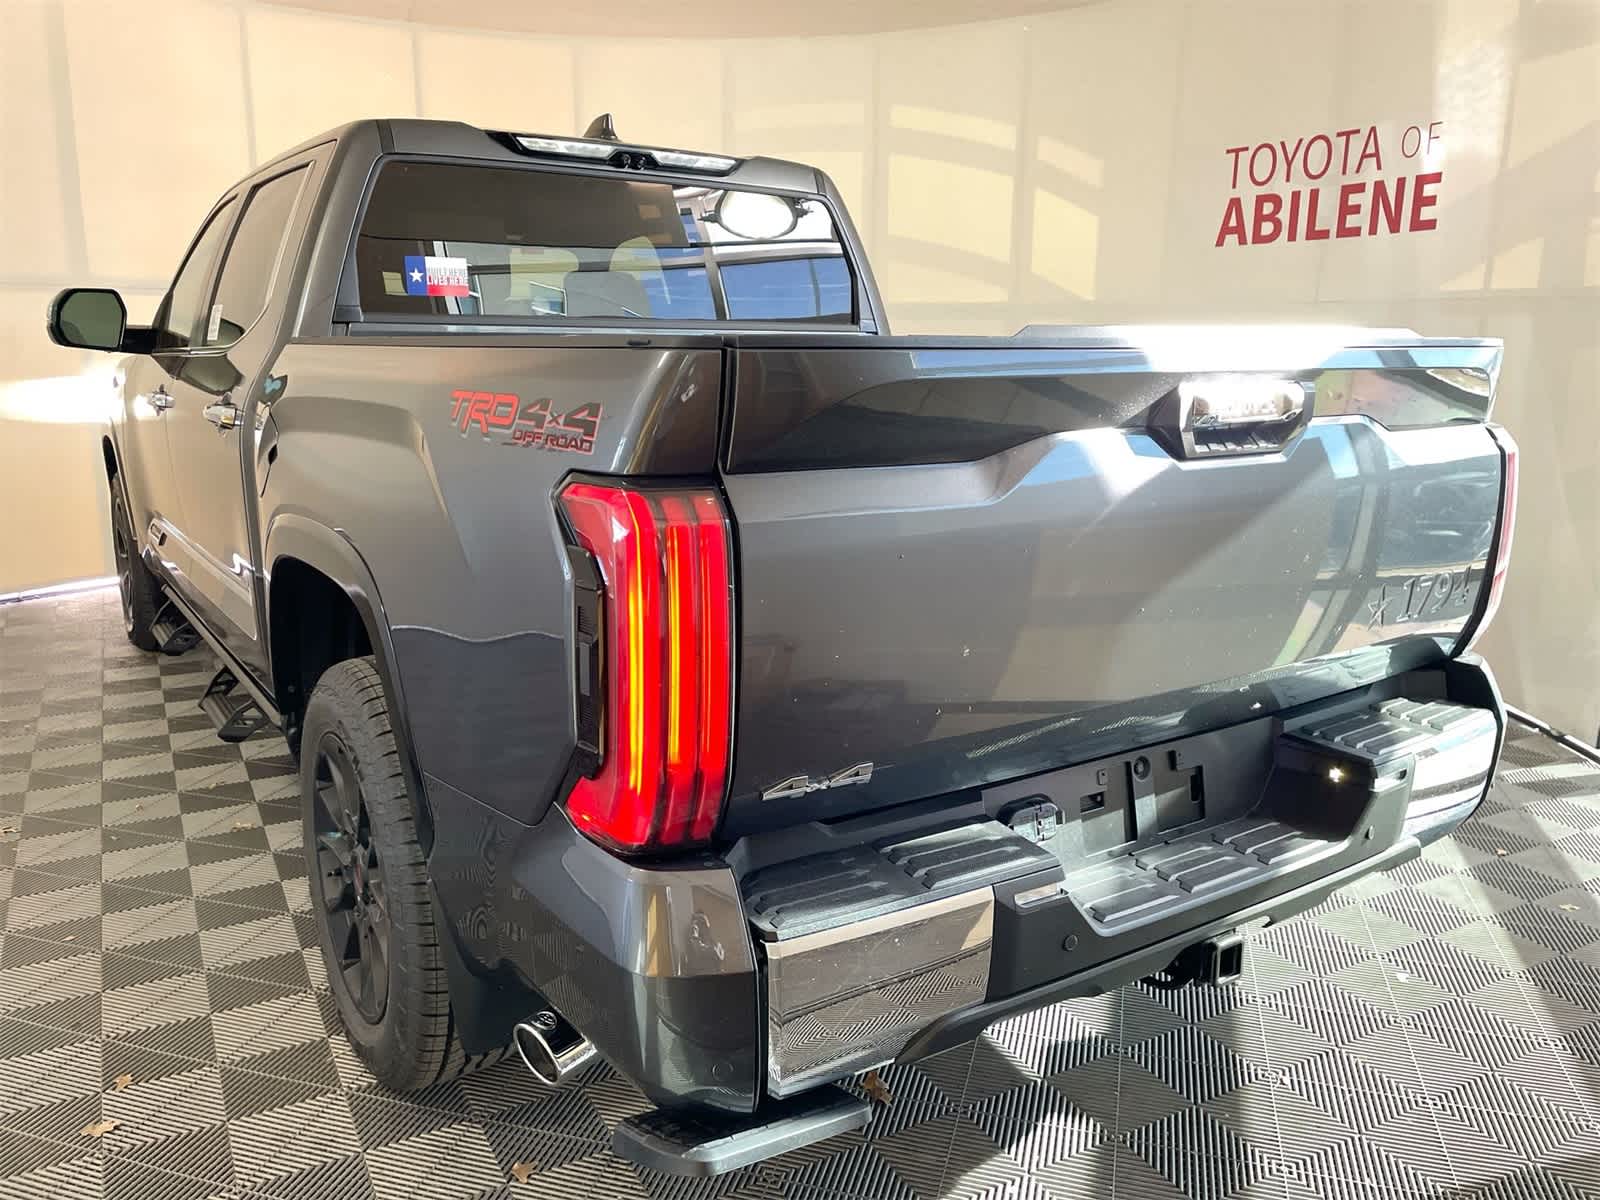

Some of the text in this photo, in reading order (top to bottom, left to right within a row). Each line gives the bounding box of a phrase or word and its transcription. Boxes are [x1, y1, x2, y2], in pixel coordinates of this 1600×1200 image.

[1225, 121, 1443, 190] TOYOTA OF
[1214, 171, 1443, 248] ABILENE
[450, 389, 520, 436] TRD
[511, 428, 595, 455] OFF ROAD
[1396, 565, 1472, 623] 1794
